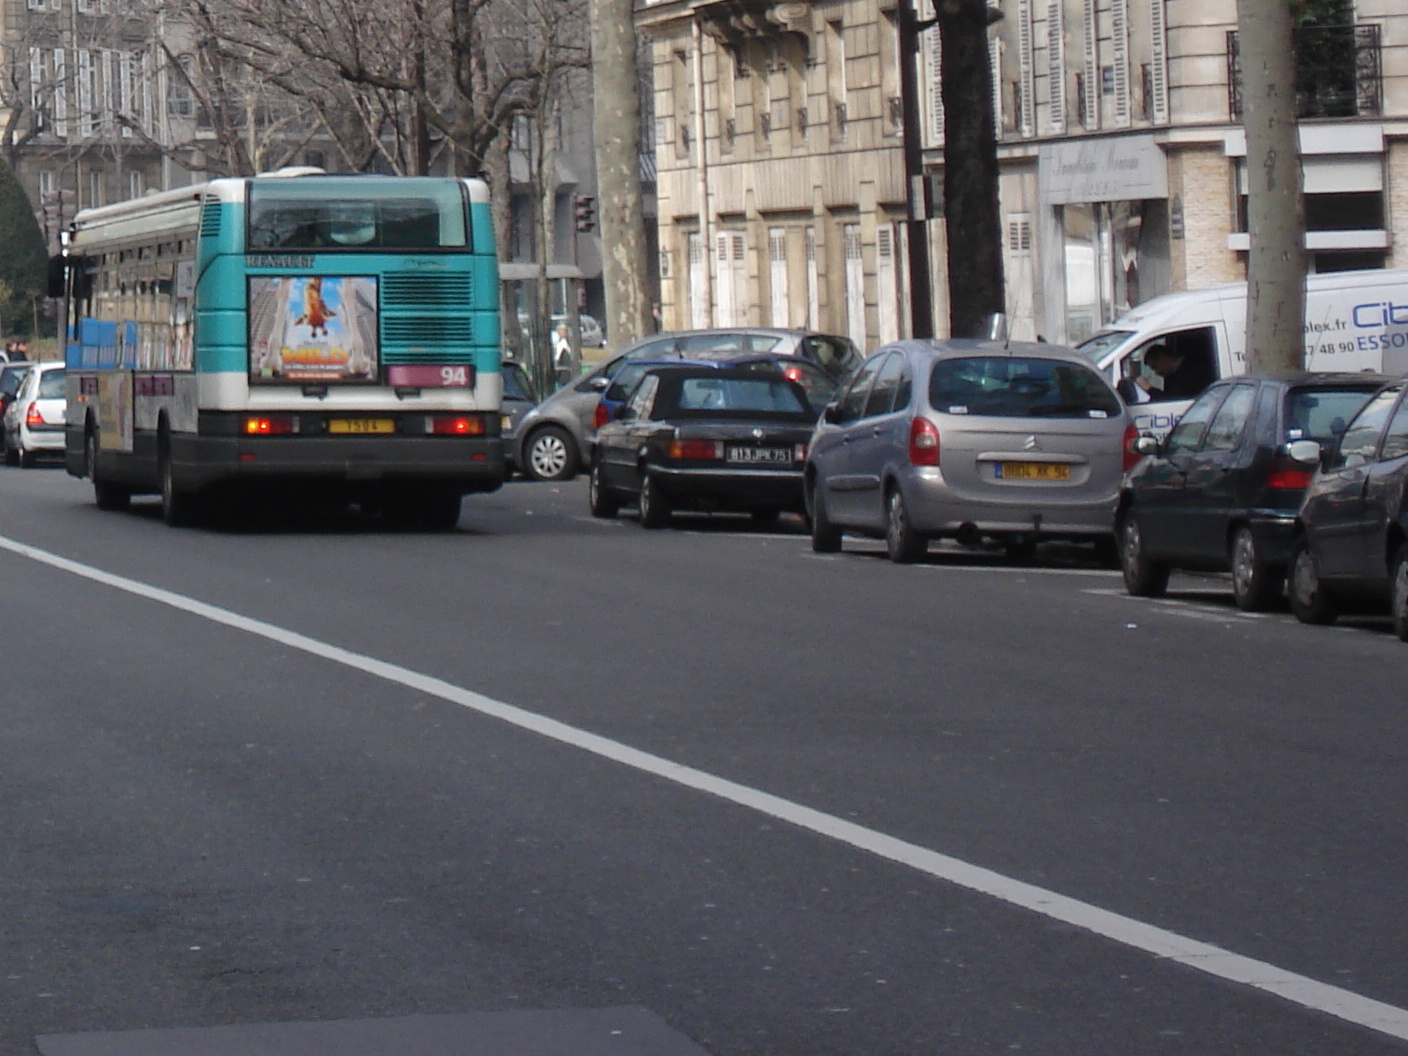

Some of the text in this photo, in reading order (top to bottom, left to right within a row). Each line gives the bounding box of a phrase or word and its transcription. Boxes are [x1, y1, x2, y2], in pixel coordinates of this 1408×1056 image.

[246, 254, 315, 267] RENAULT
[1319, 342, 1335, 355] 48
[1339, 341, 1355, 353] 90
[1355, 331, 1408, 351] ESSO
[281, 347, 349, 365] WILD
[440, 367, 468, 385] 94
